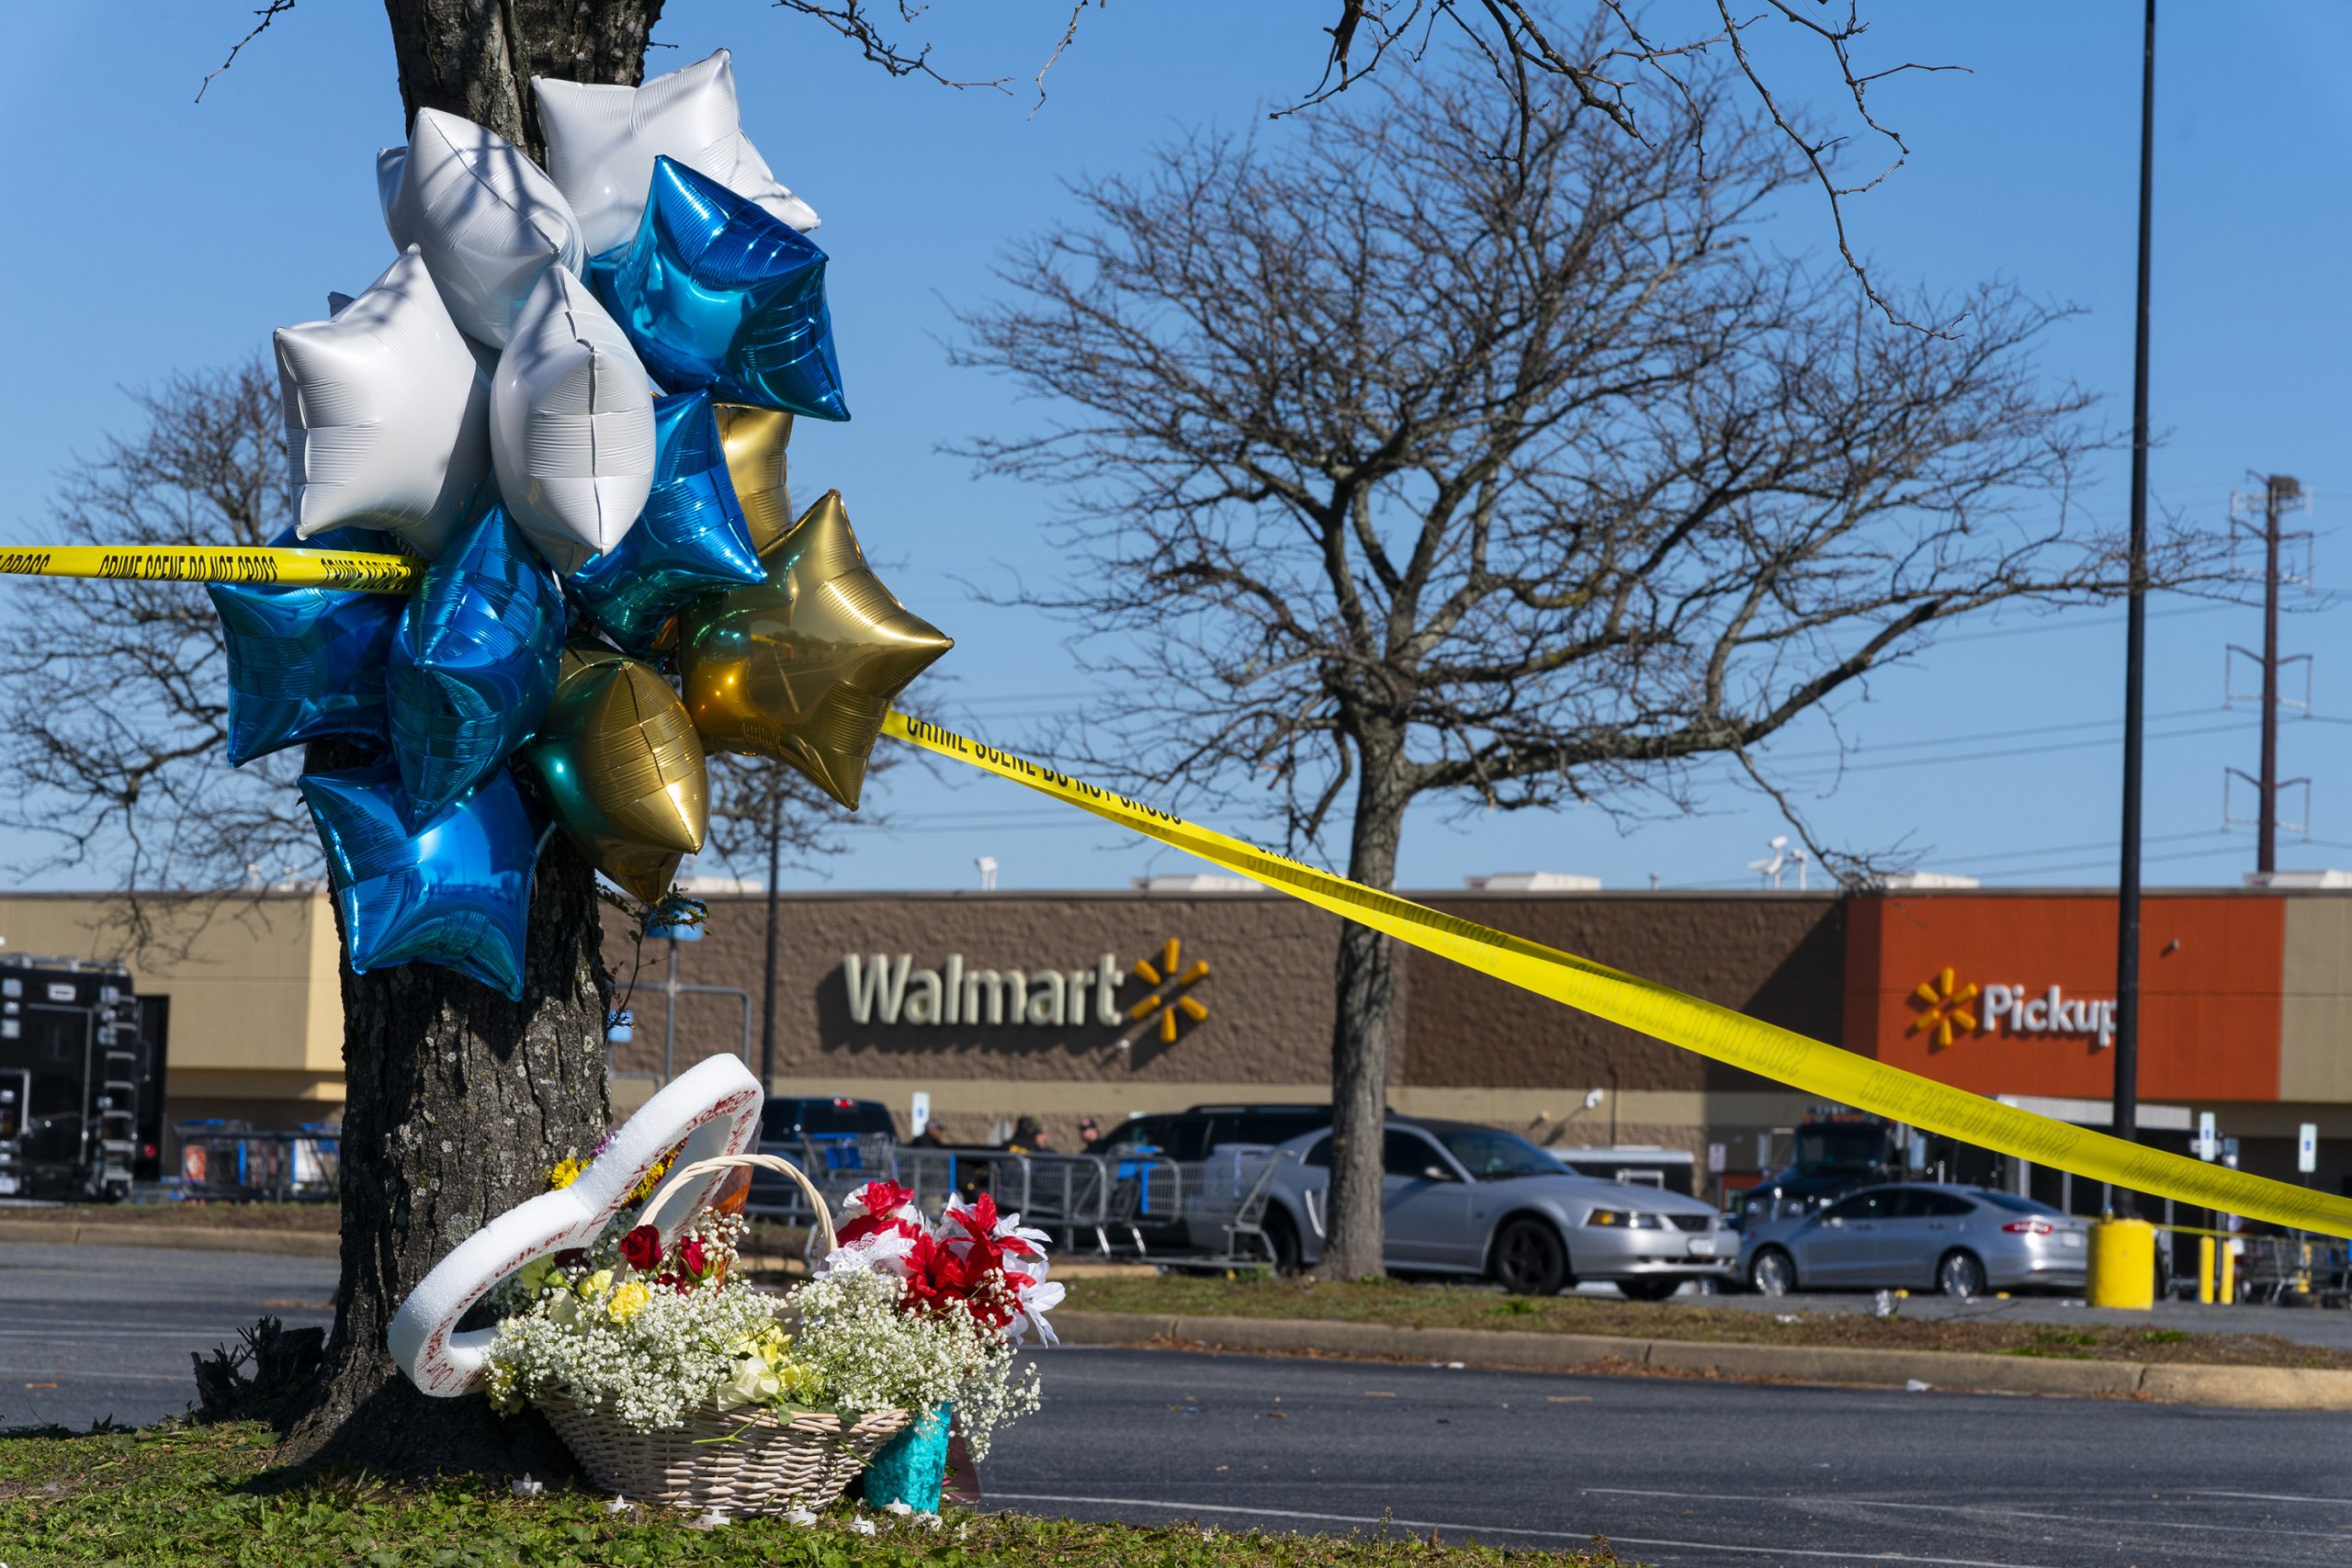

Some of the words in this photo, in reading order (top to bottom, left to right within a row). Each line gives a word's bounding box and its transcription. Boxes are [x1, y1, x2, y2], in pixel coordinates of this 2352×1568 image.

[96, 554, 142, 579] CRIME
[143, 554, 186, 581] SCENE
[186, 555, 207, 581] DO
[209, 555, 233, 582] NOT
[237, 555, 278, 583] CROSS
[842, 952, 1125, 1027] Walmart
[1983, 984, 2118, 1047] Pickup
